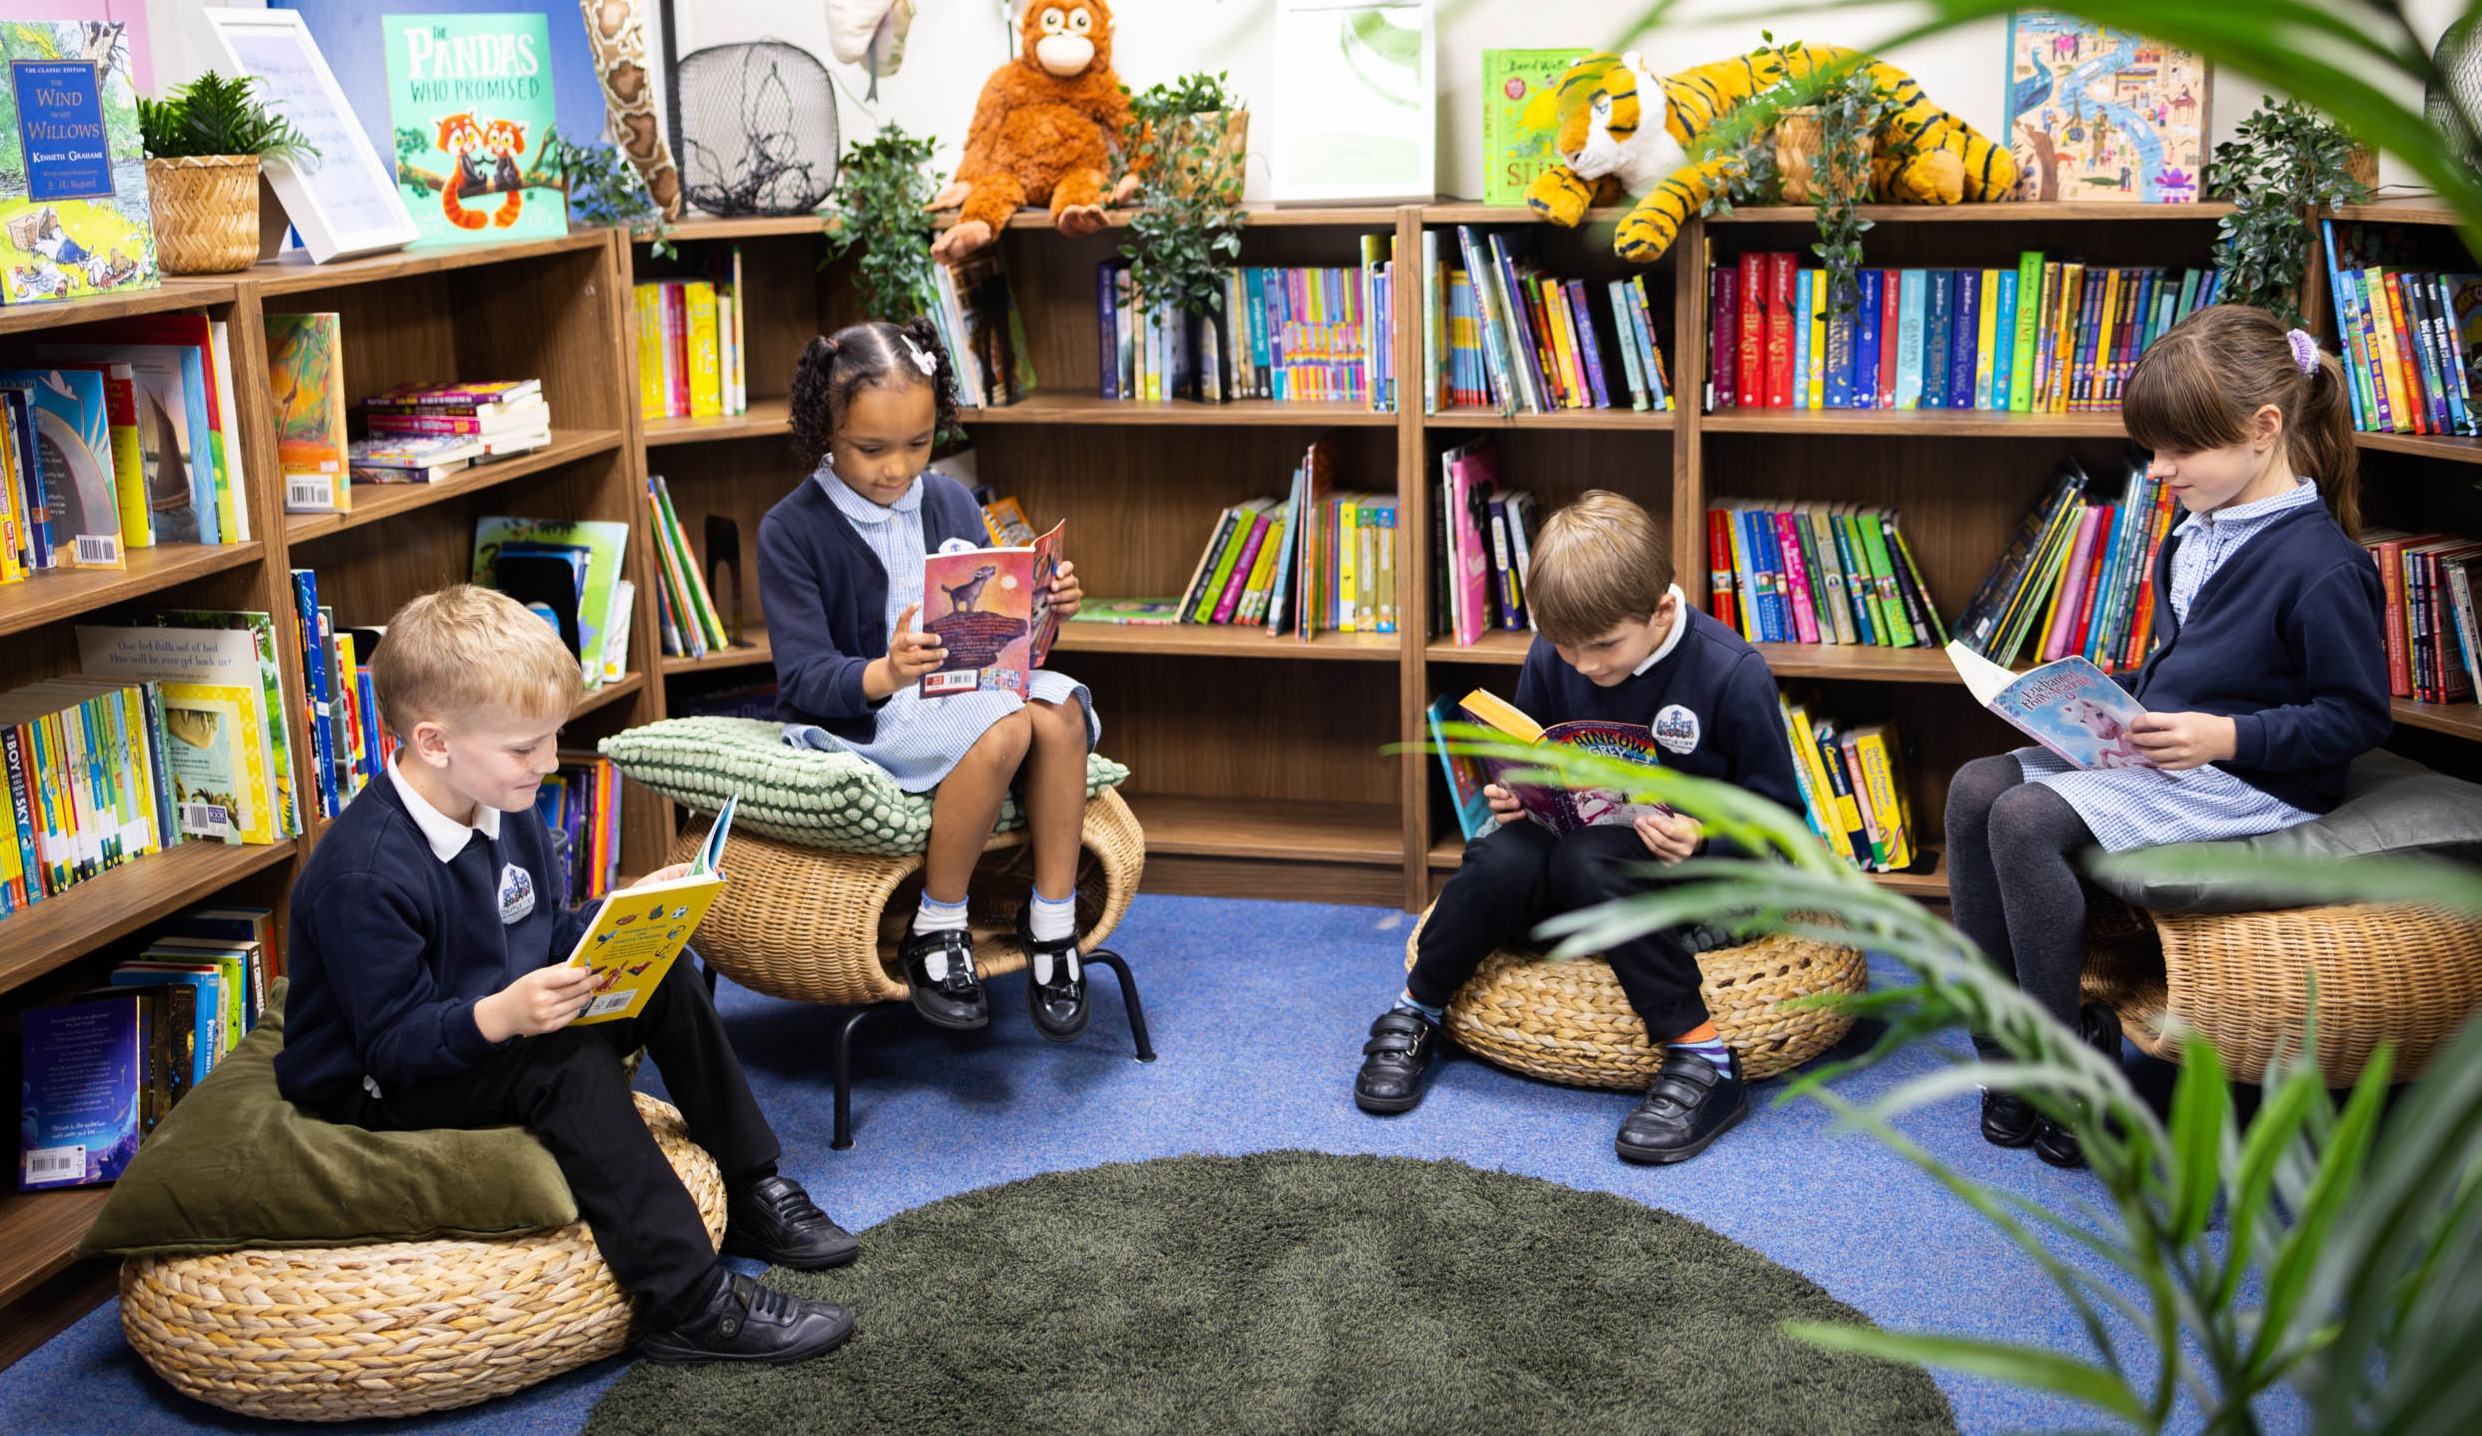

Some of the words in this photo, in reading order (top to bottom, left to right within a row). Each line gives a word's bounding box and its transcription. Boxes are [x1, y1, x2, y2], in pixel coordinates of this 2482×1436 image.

[432, 26, 447, 40] THE
[403, 27, 540, 79] PANDAS
[36, 88, 83, 107] WIND
[410, 80, 448, 103] WHO
[454, 77, 540, 102] PROMISED
[28, 121, 100, 140] WILLOWS
[33, 152, 65, 163] KENNETH
[68, 151, 103, 162] GRAHAME
[2419, 319, 2429, 334] DOG
[2433, 317, 2445, 334] DOG
[2365, 332, 2380, 361] BARB
[1570, 730, 1648, 754] AINBOW
[6, 741, 21, 771] BOY
[1588, 745, 1627, 759] GREY
[15, 798, 29, 826] SKY
